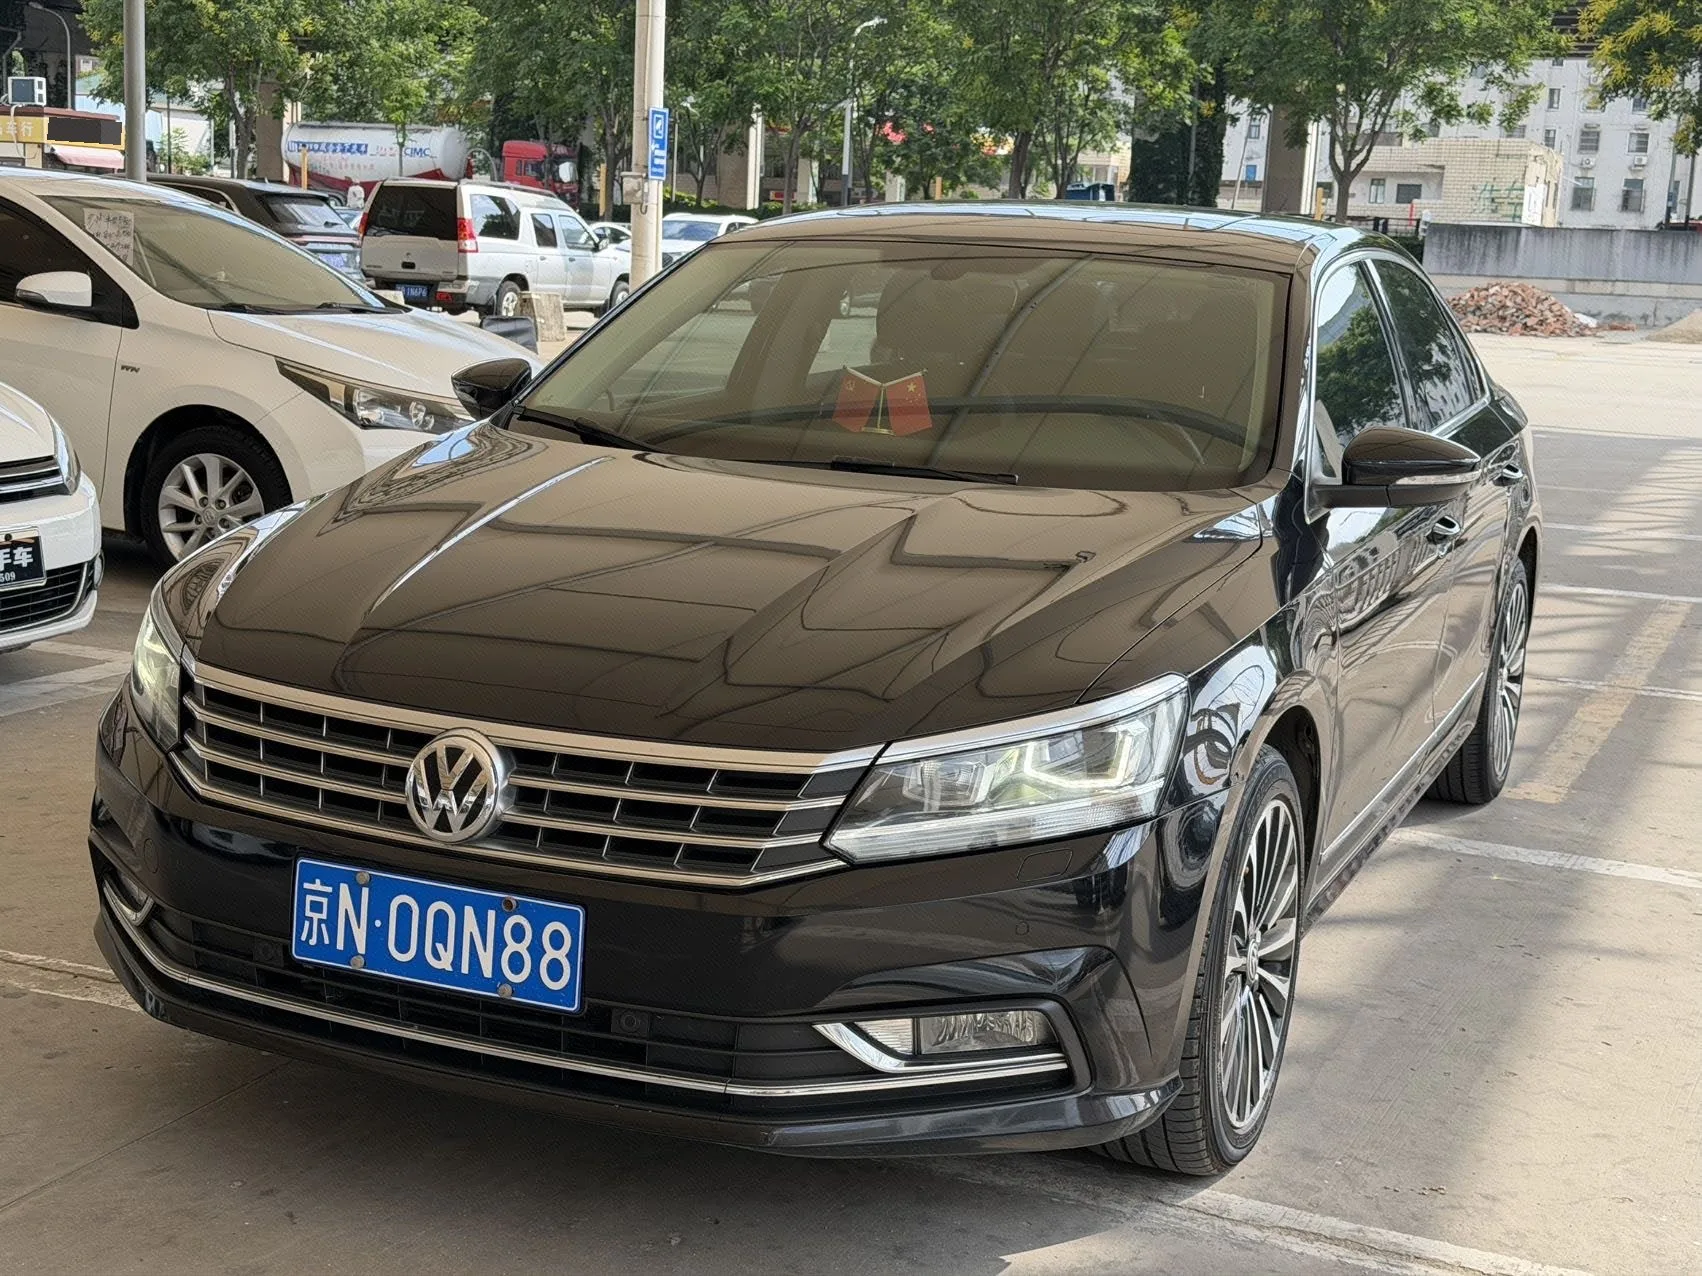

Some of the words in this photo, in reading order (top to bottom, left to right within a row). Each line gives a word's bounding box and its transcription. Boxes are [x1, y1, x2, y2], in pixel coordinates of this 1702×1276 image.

[0, 121, 33, 137] 车行
[404, 147, 431, 158] CIMC
[300, 878, 572, 991] 京N·0QN88
